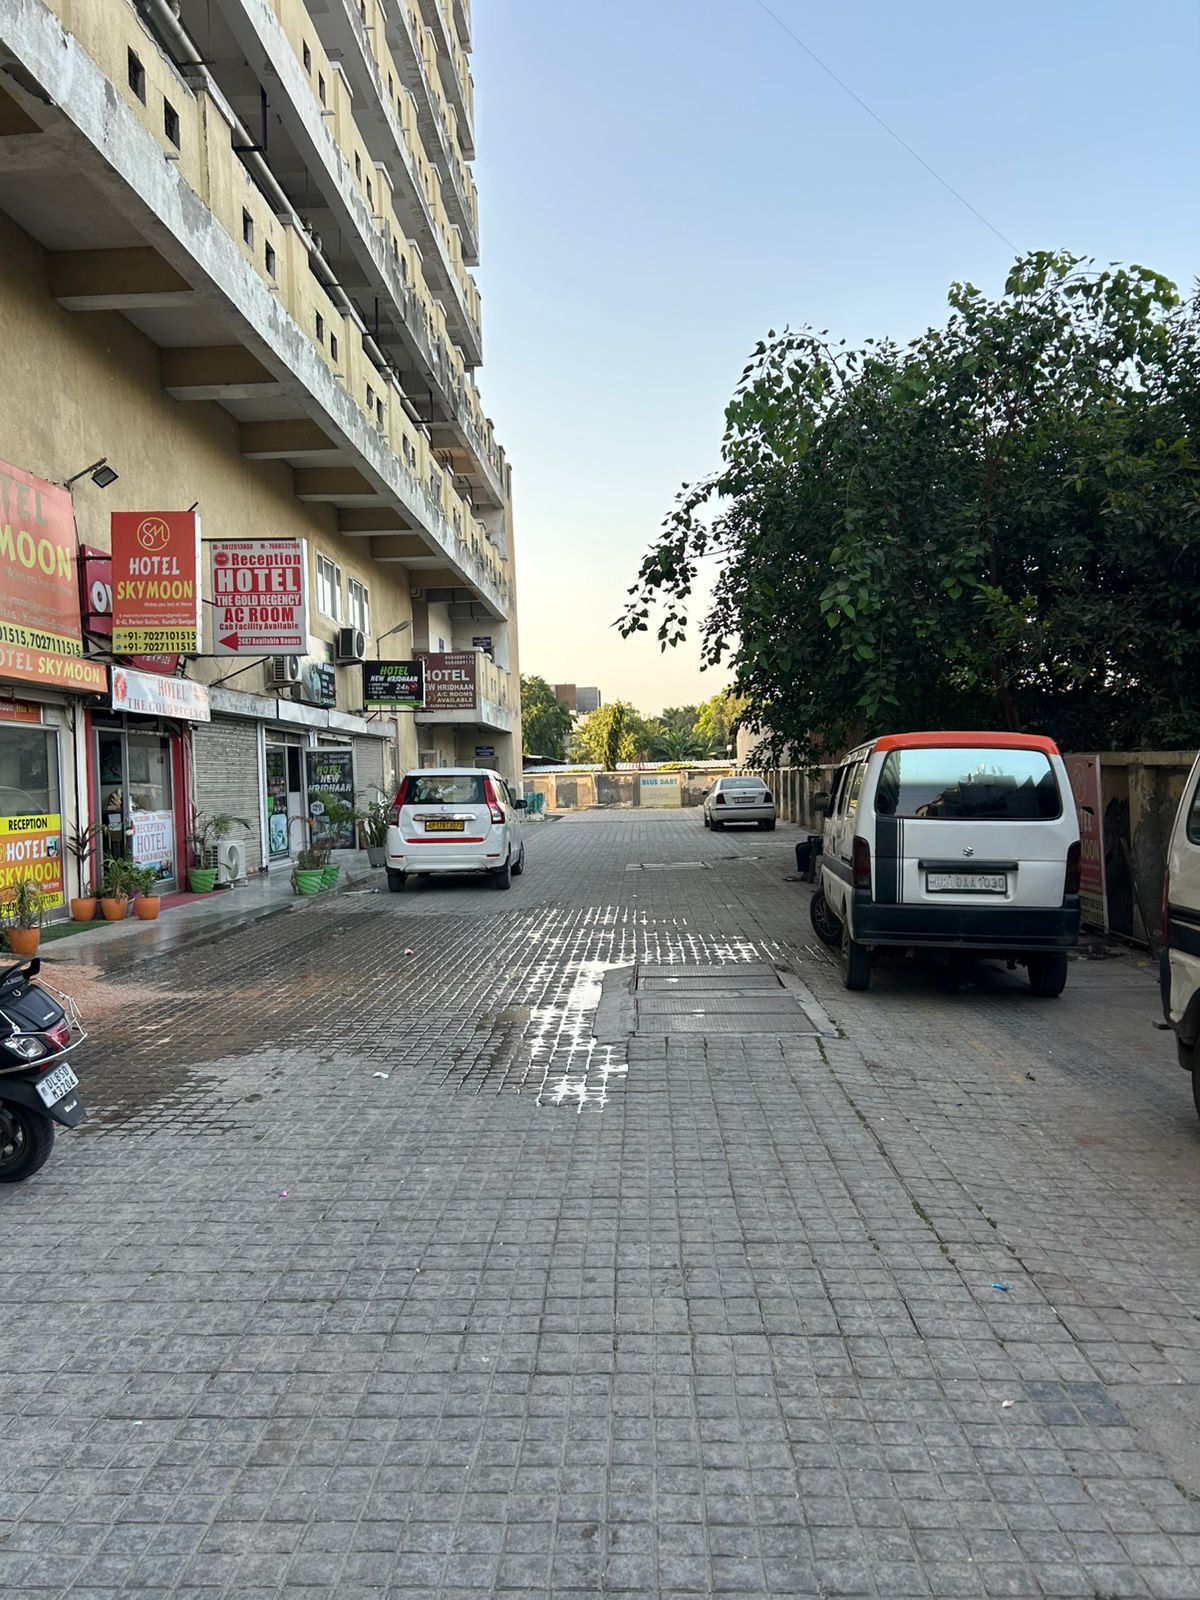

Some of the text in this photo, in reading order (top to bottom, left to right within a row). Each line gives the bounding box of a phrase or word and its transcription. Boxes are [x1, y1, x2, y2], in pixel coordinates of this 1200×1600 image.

[231, 552, 300, 567] Reception
[128, 556, 180, 576] HOTEL
[217, 568, 298, 592] HOTEL
[216, 594, 300, 606] THE GOLD REGENCY
[224, 607, 294, 622] AC ROOM
[235, 623, 262, 631] Facility
[264, 622, 299, 630] Available
[143, 632, 197, 641] 7027101515
[143, 642, 197, 651] 7027111515
[380, 665, 409, 676] HOTEL
[157, 680, 187, 700] HOTEL
[437, 683, 474, 691] HRIDHAAN
[128, 698, 208, 720] THE GOLD REGENCY
[316, 765, 342, 774] HOTEL
[320, 774, 340, 783] NEW
[308, 783, 352, 792] HRIDHAAN
[8, 818, 48, 831] RECEPTION
[136, 823, 166, 834] RECEPTION
[137, 833, 167, 853] HOTEL
[6, 839, 47, 862] HOTEL
